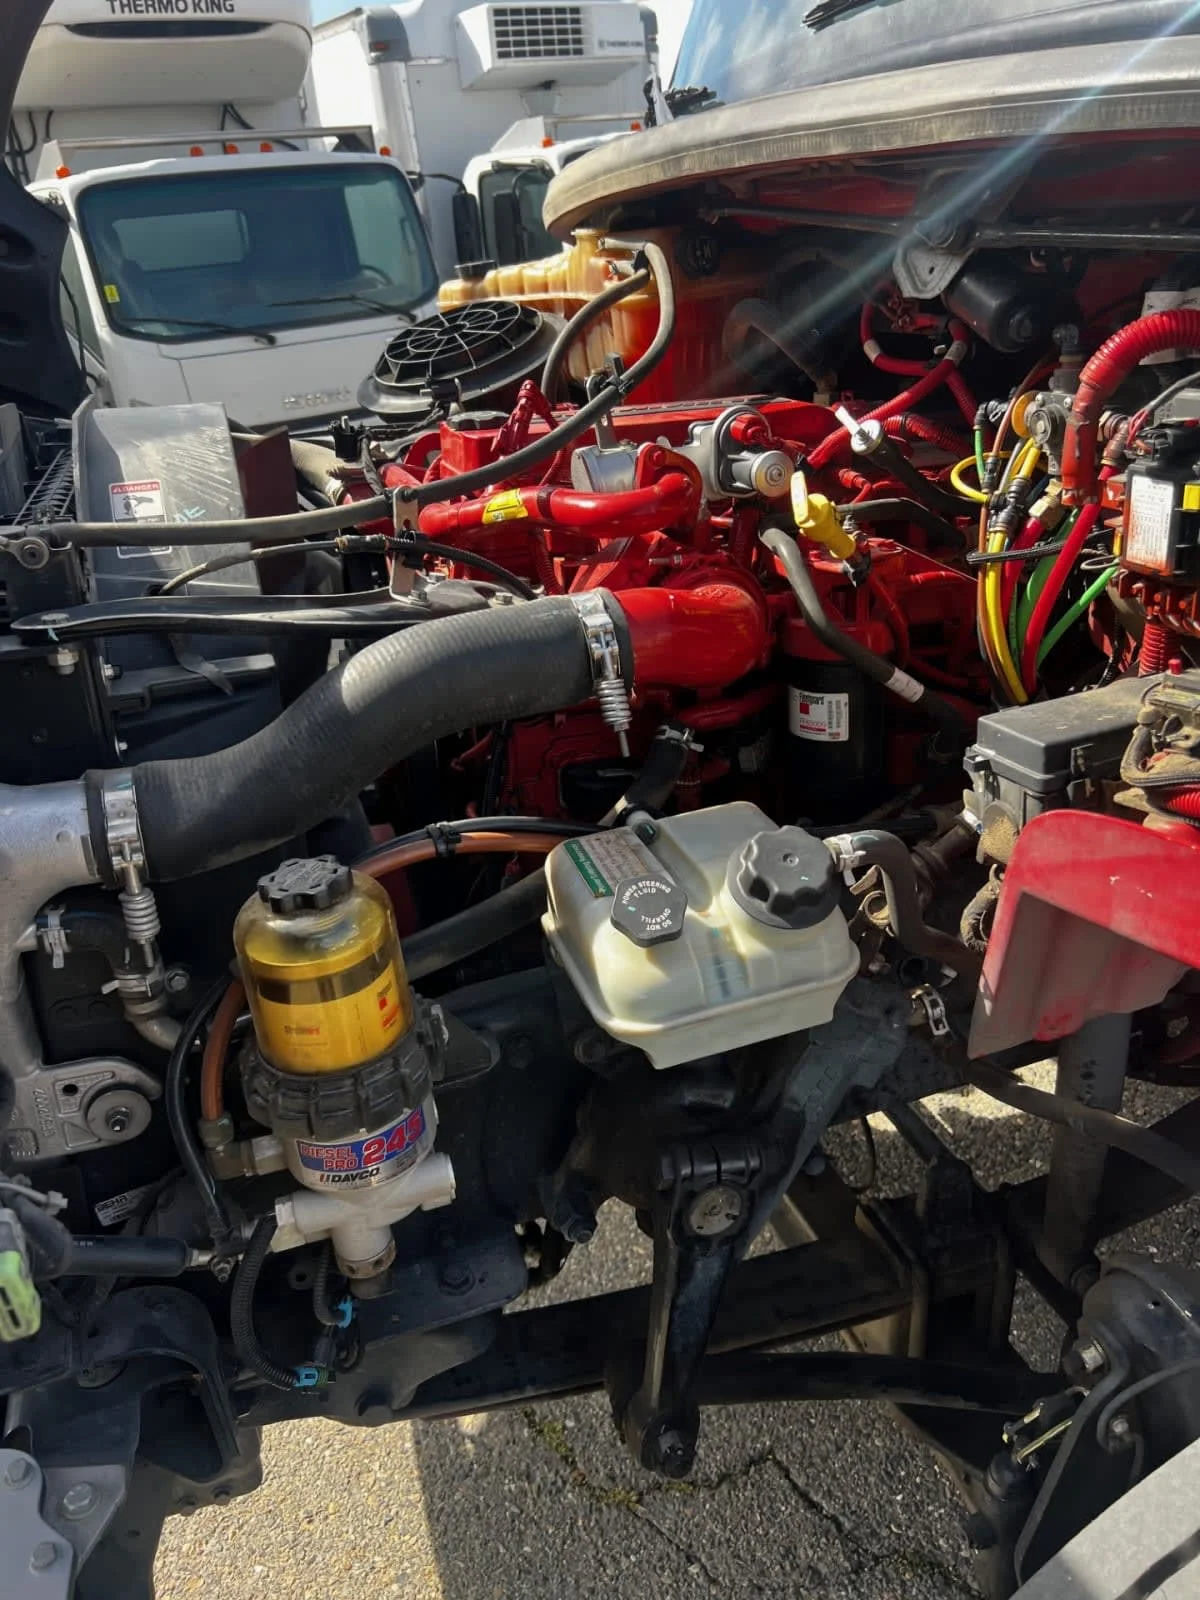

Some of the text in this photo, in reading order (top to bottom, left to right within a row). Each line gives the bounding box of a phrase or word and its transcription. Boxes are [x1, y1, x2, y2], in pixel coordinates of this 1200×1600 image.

[106, 0, 235, 14] THERMO KING
[622, 881, 671, 905] POWER STEERING
[633, 887, 657, 898] FLUID
[641, 908, 672, 924] OVERFILL
[646, 922, 661, 931] NOT
[362, 1110, 423, 1168] 245
[300, 1145, 357, 1158] DIESEL
[323, 1158, 358, 1171] PRO
